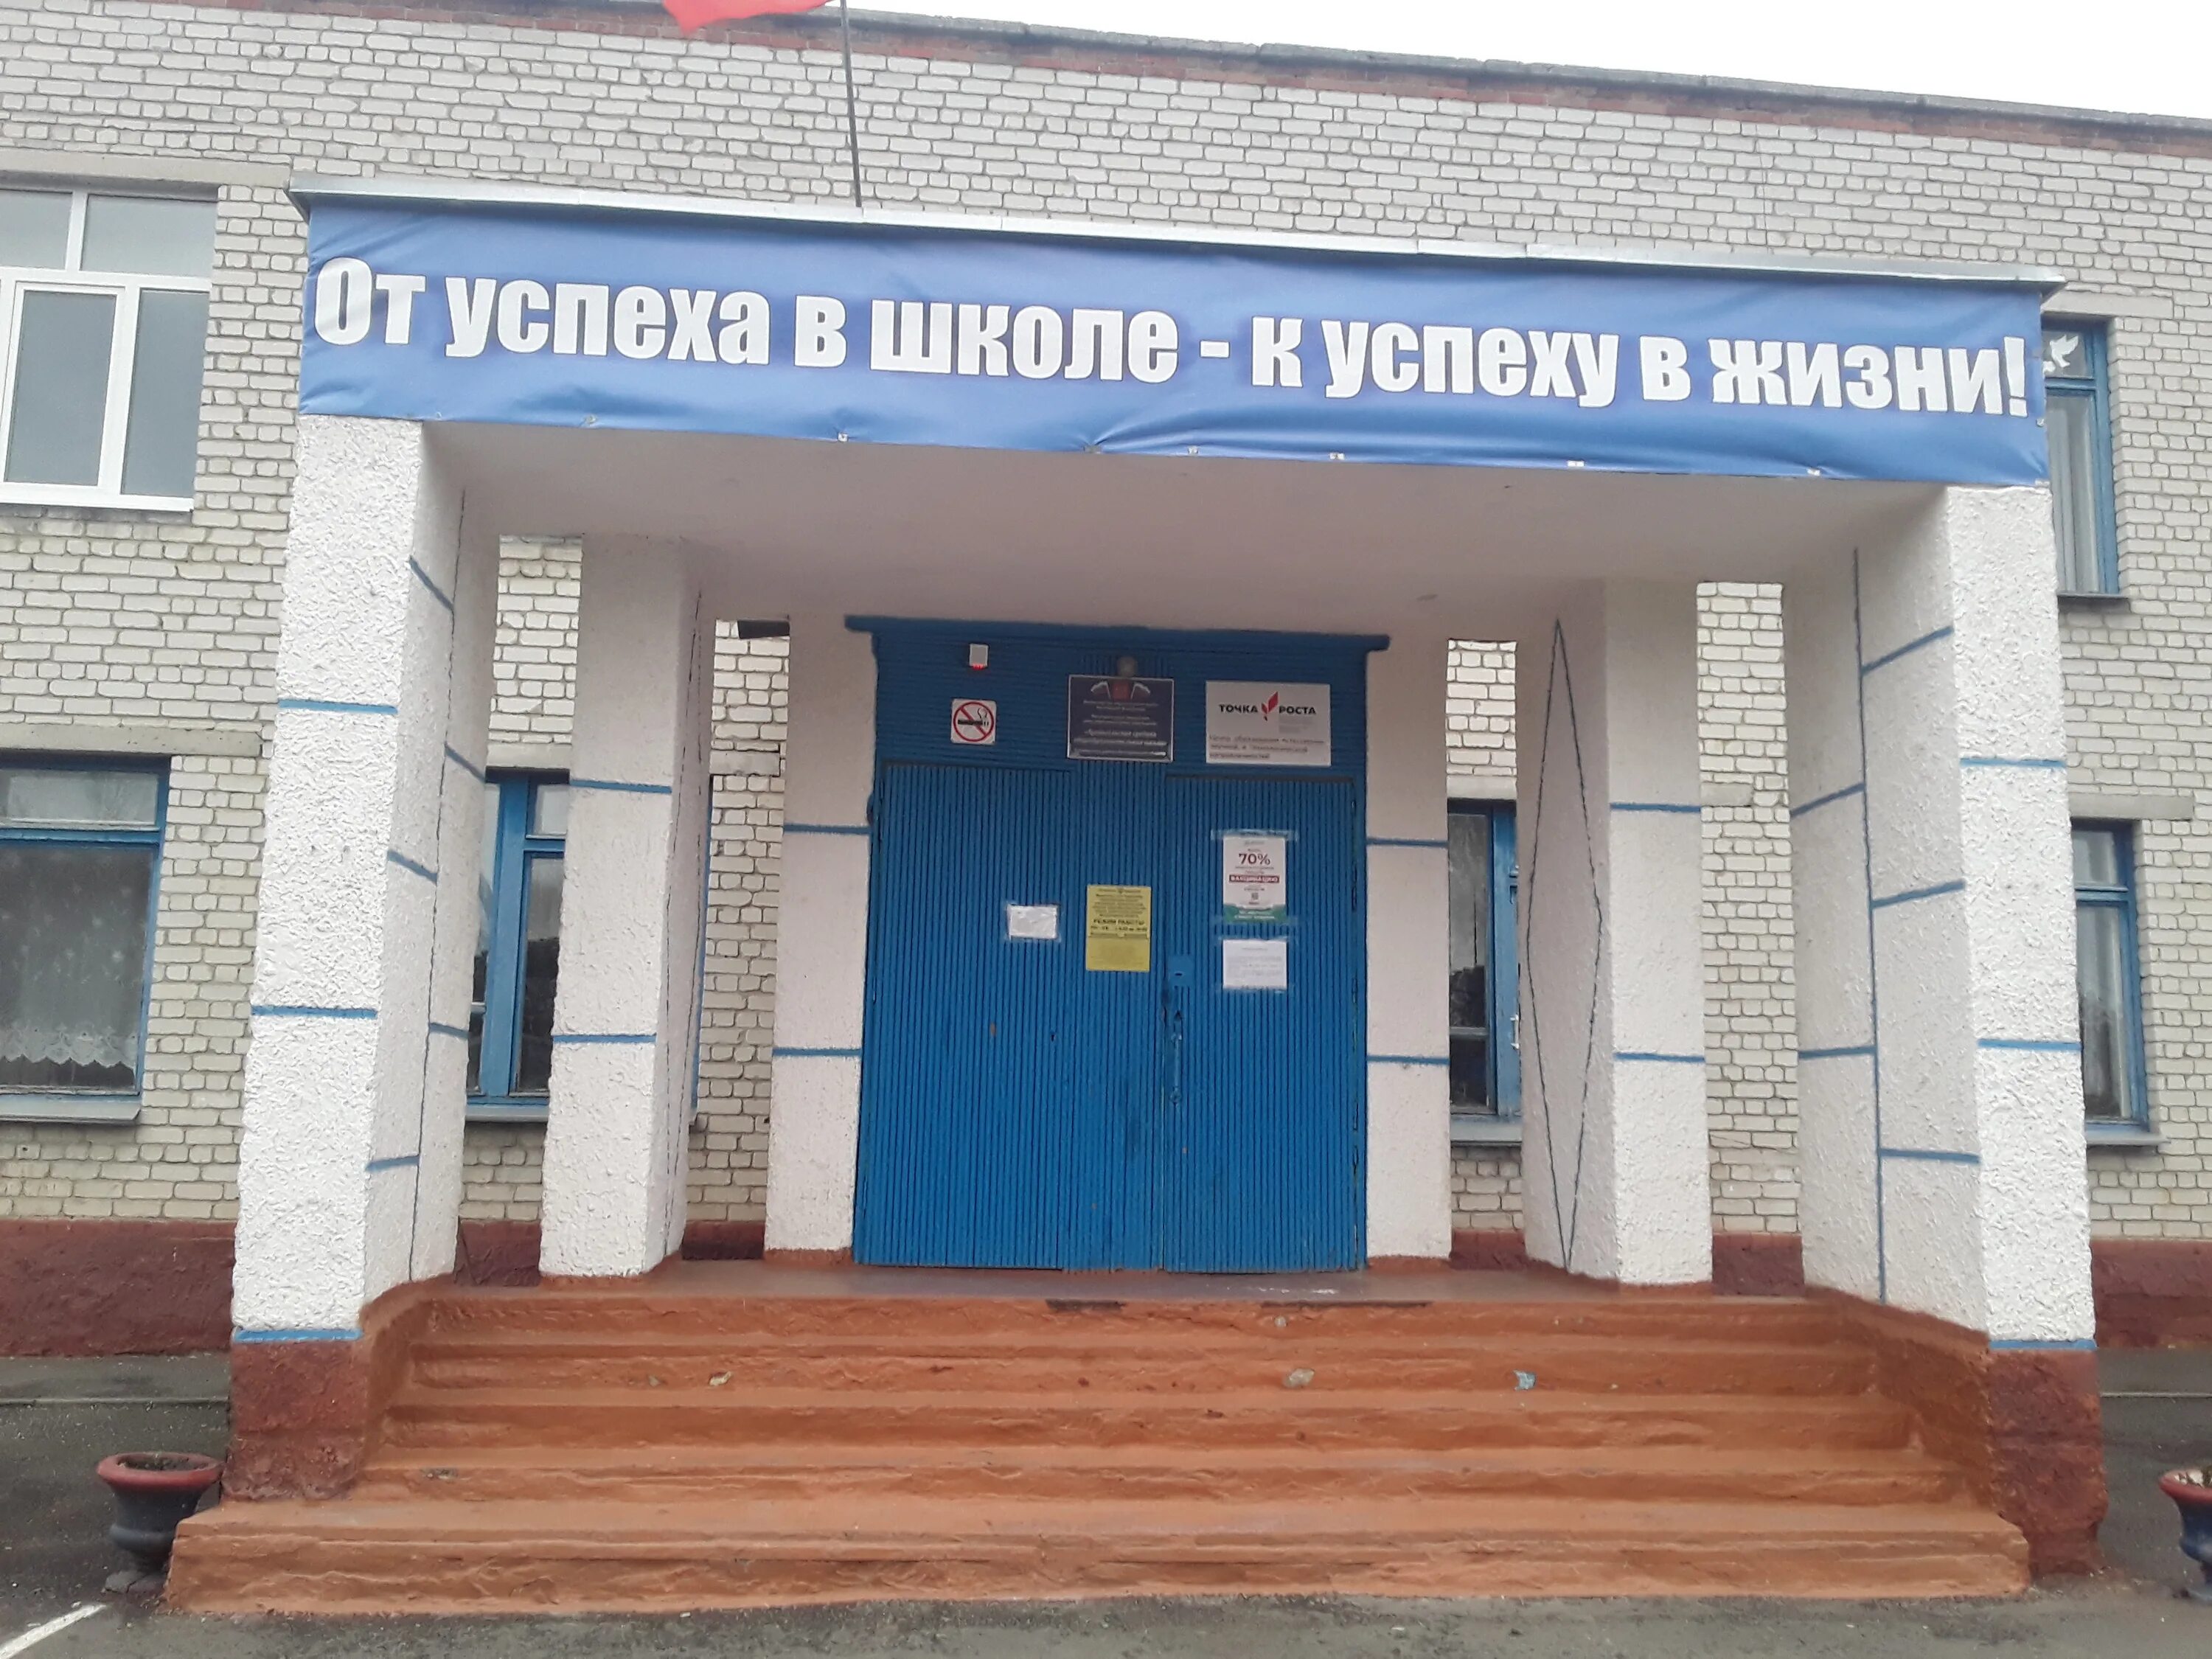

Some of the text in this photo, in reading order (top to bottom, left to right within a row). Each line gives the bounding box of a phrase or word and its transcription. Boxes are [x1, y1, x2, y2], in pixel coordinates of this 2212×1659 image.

[313, 257, 426, 346] От
[445, 276, 771, 366] успеха
[793, 294, 848, 368] в
[869, 299, 1179, 383] школе
[1251, 316, 1304, 388] к
[1320, 319, 1620, 408] успеху
[1639, 335, 1691, 402] в
[1707, 335, 2028, 417] жизни!
[1219, 704, 1316, 715] ТОЧКА РОСТА
[1239, 853, 1270, 865] 70%
